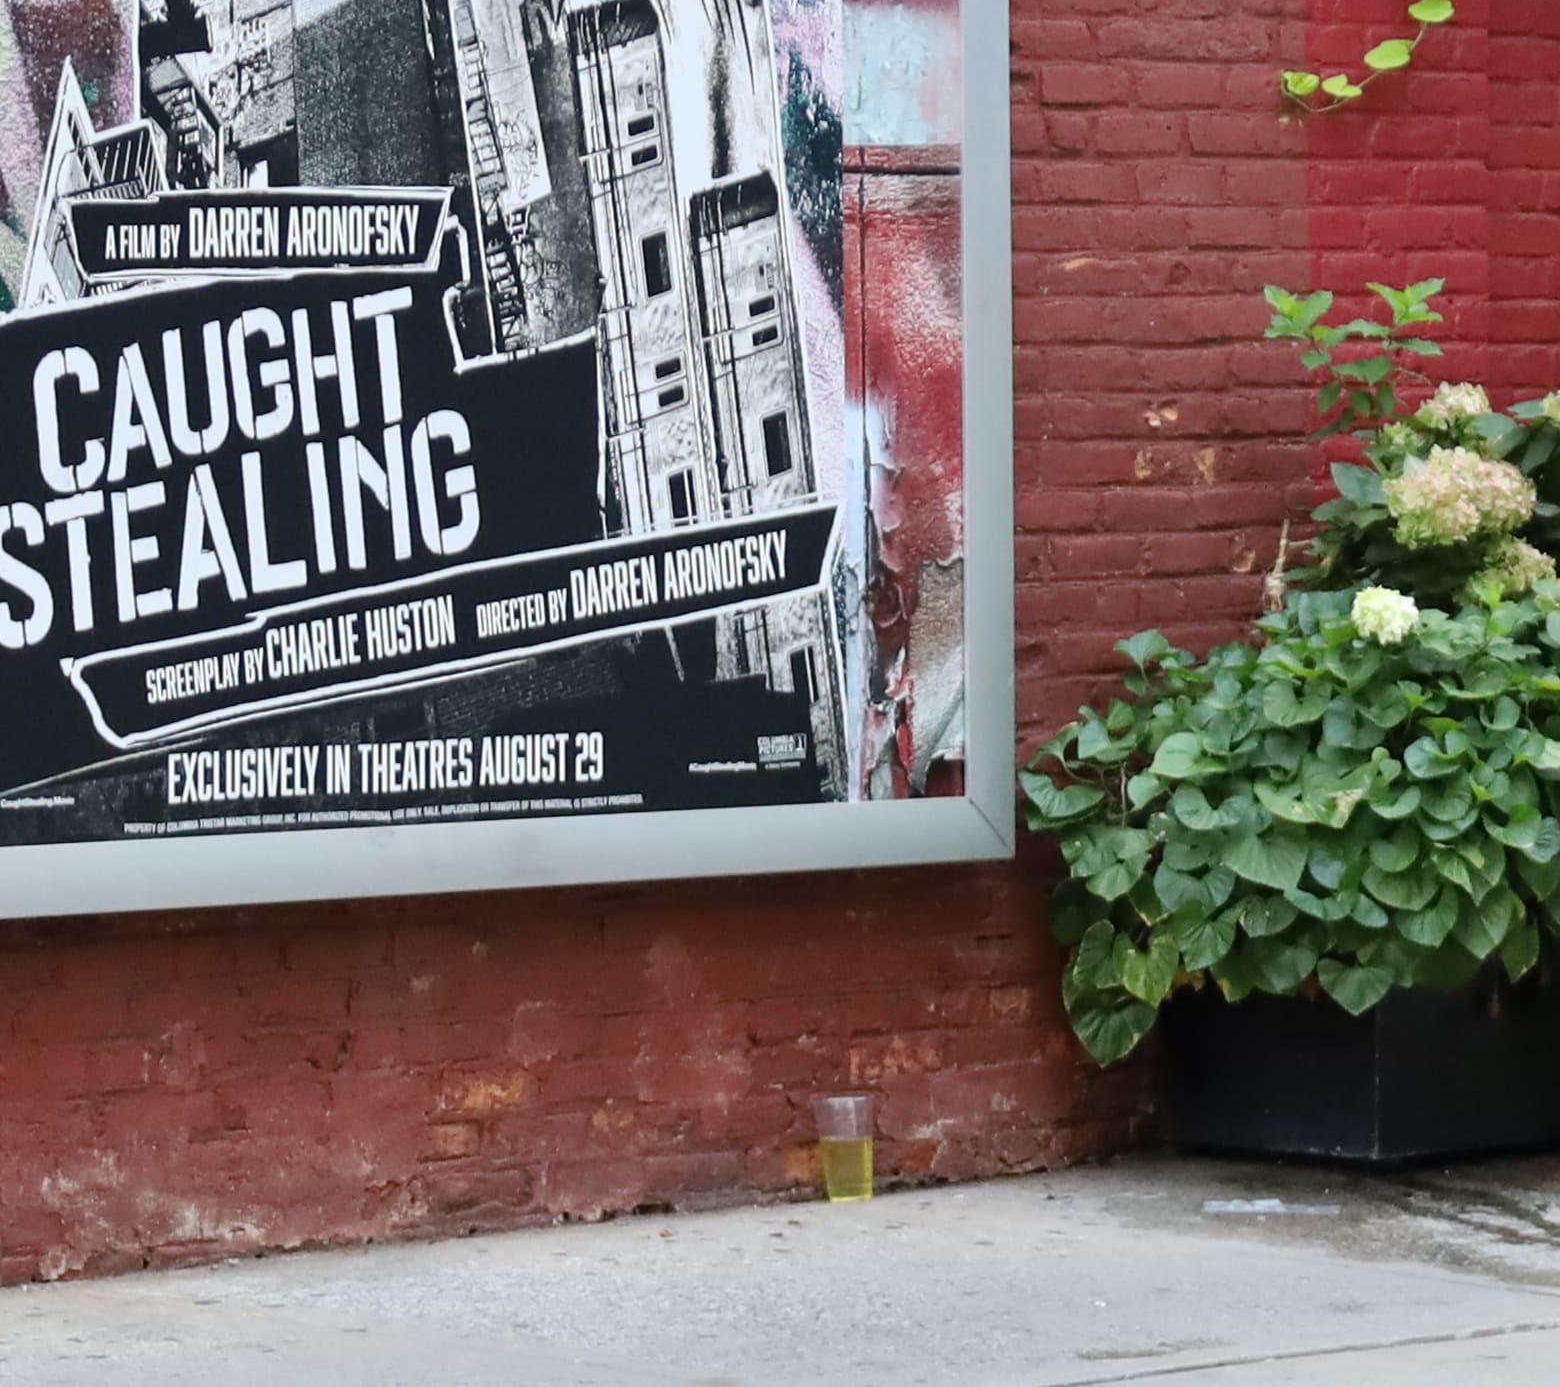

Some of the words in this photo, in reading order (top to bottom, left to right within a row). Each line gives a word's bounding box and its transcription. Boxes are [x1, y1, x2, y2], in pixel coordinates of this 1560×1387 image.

[105, 225, 117, 260] A
[119, 225, 157, 260] FILM
[161, 223, 181, 258] BY
[188, 206, 280, 259] DARREN
[286, 204, 420, 258] ARONOFSKY
[33, 286, 413, 493] CAUGHT
[146, 650, 241, 705] SCREENPLAY
[244, 645, 265, 686] BY
[265, 614, 362, 679] CHARLIE
[367, 594, 457, 656] HUSTON
[476, 593, 546, 639] DIRECTED
[548, 588, 568, 625] BY
[570, 555, 658, 619] DARREN
[663, 529, 788, 601] ARONOFSKY
[167, 741, 319, 804] EXCLUSIVELY
[324, 743, 351, 796] IN
[357, 737, 474, 794] THEATRES
[479, 732, 570, 788] AUGUST
[575, 730, 605, 782] 29
